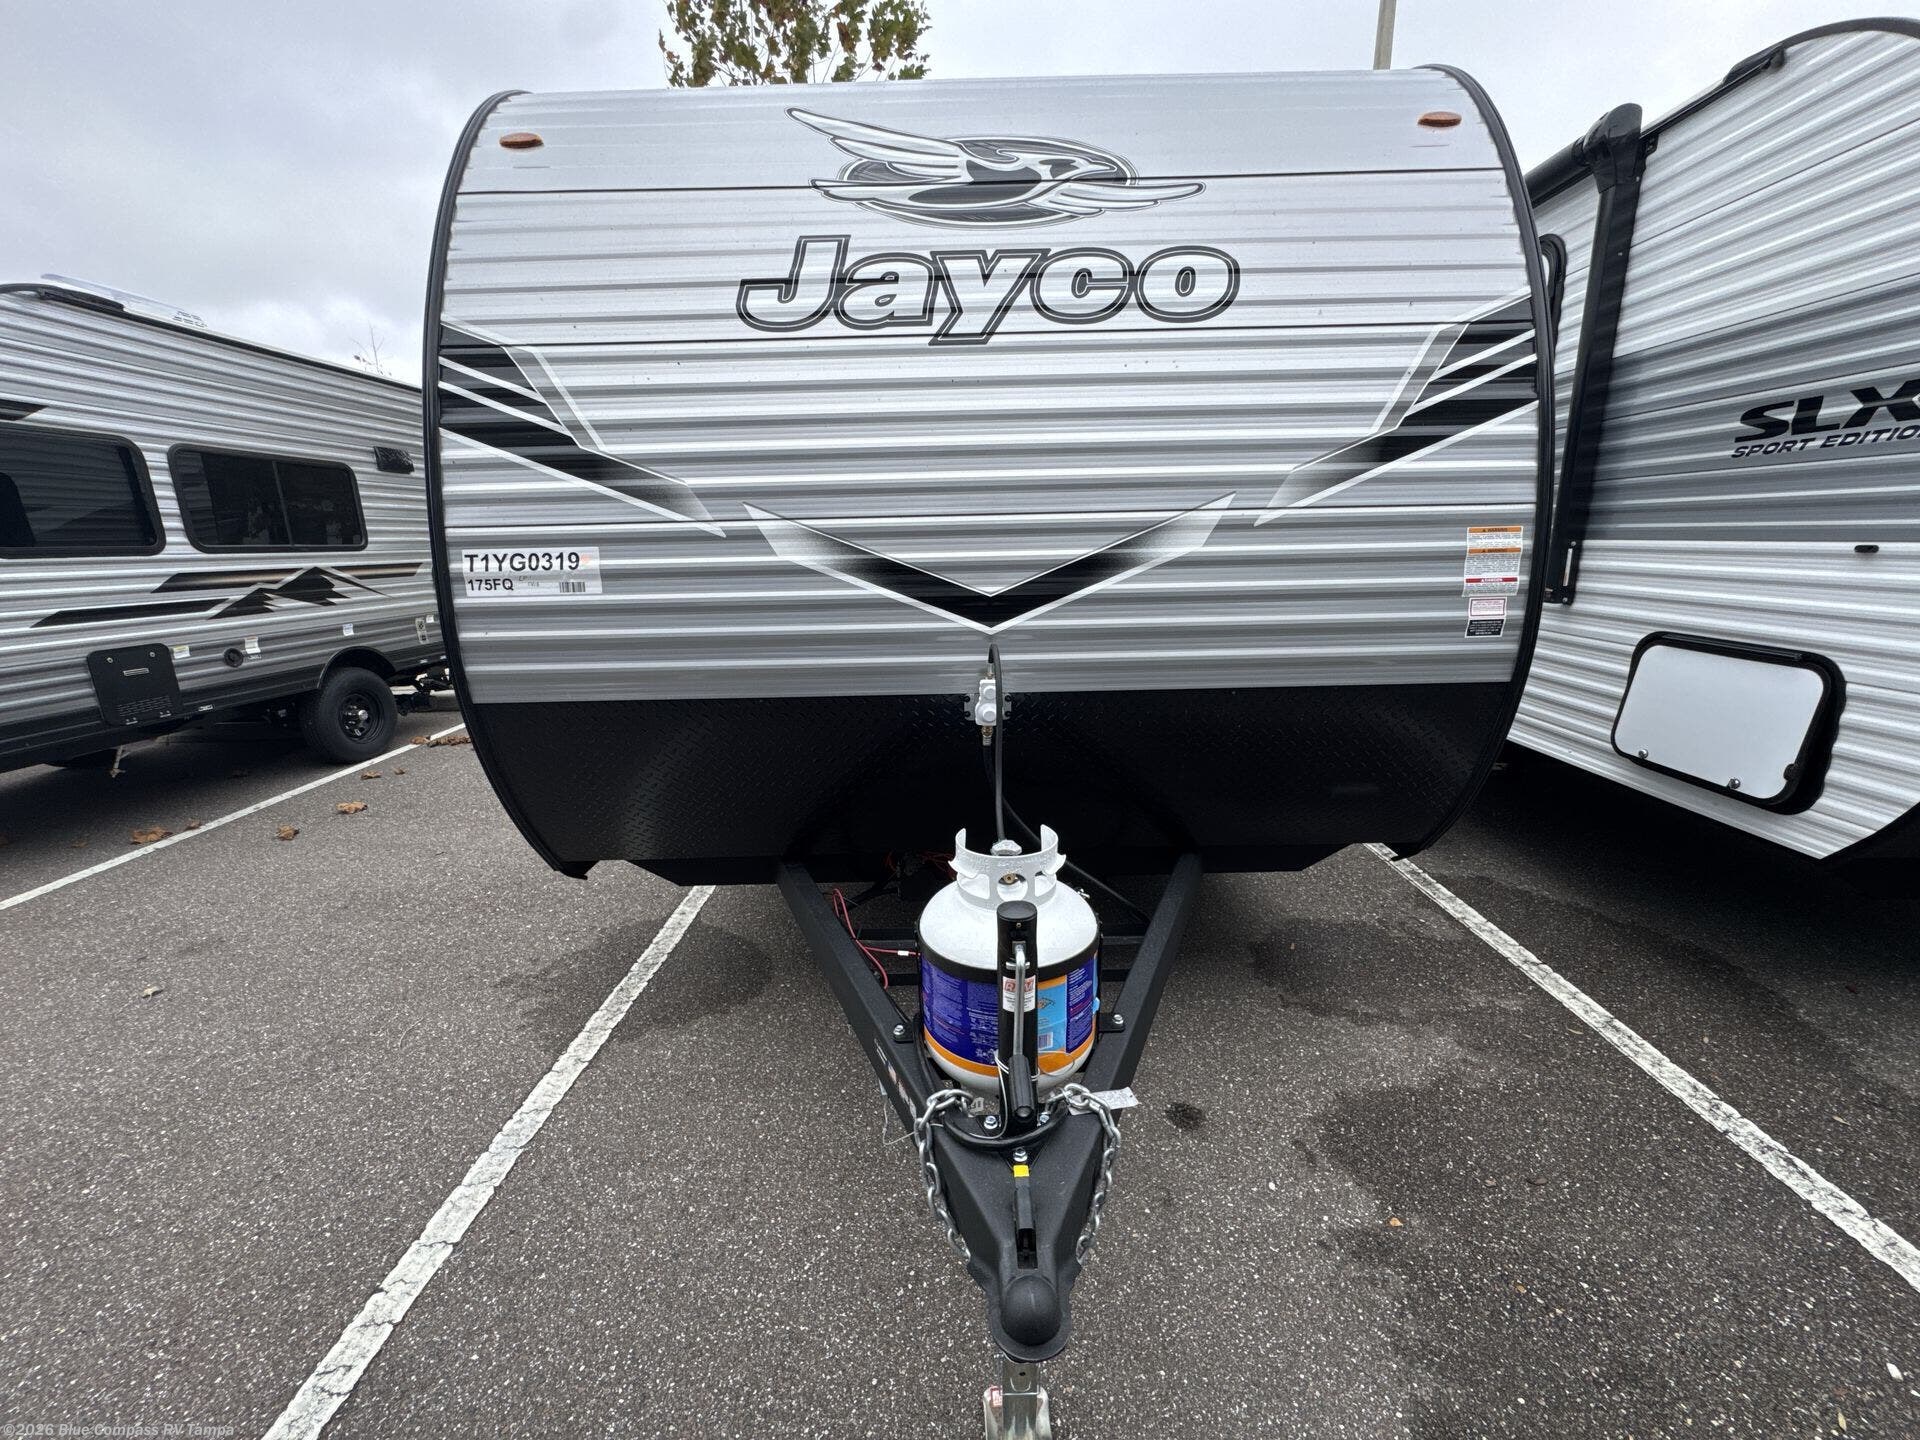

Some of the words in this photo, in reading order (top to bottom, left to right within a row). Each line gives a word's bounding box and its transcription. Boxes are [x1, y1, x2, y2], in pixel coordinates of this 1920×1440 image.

[735, 234, 1241, 346] Jayco
[1734, 379, 1920, 443] SLX
[1731, 437, 1816, 458] SPORT
[1819, 424, 1920, 448] EDITIO
[464, 552, 580, 572] T1YG0319
[467, 578, 514, 591] 175FQ
